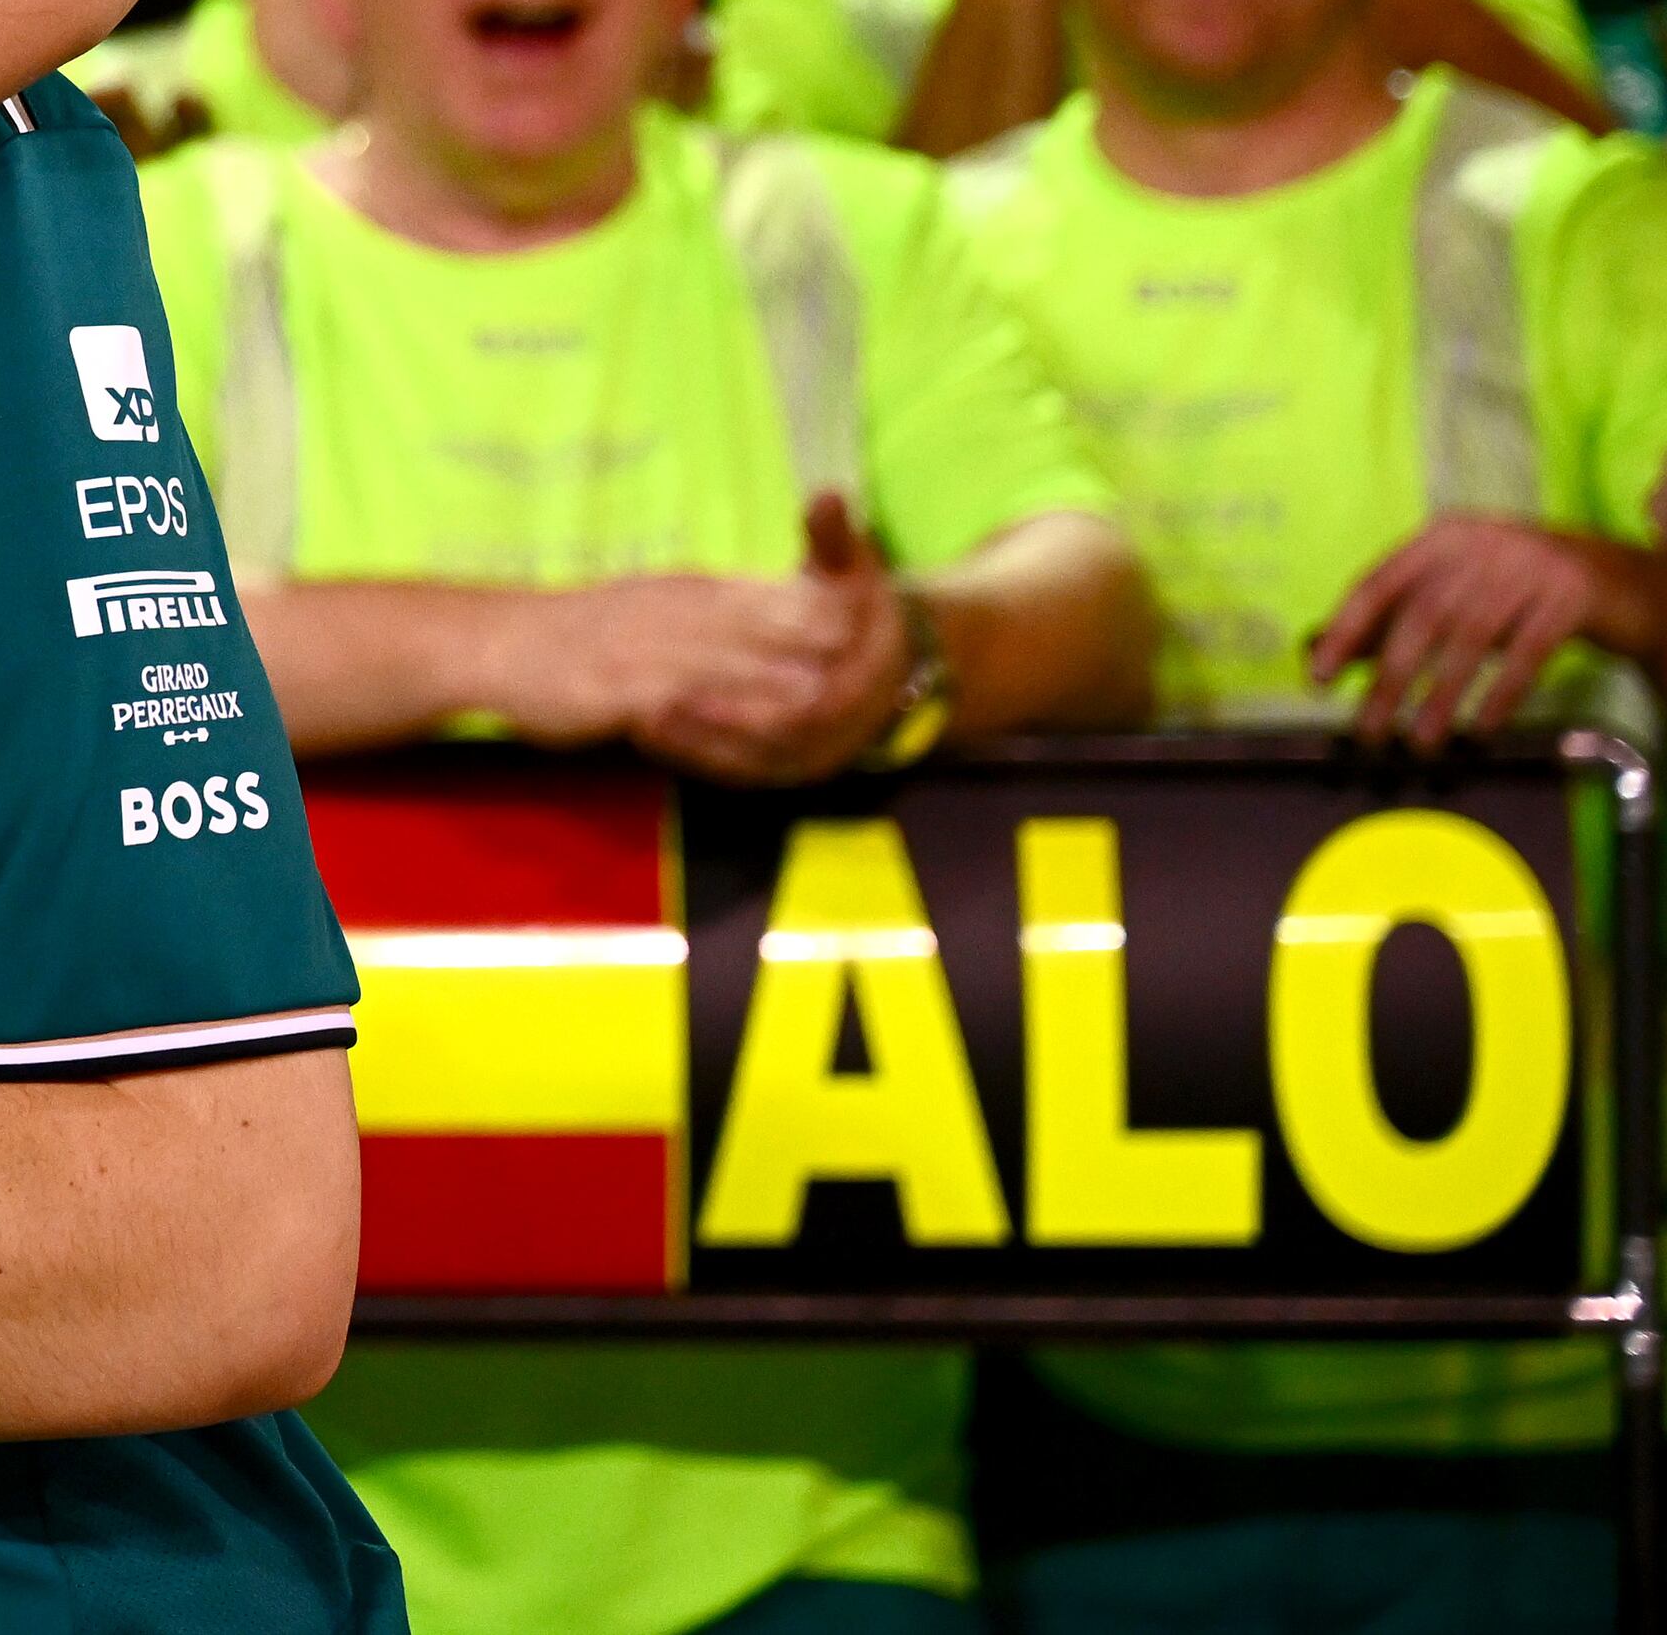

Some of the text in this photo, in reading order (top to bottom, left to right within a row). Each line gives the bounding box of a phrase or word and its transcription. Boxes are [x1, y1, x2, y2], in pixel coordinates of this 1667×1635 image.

[75, 475, 188, 539] EPOS
[66, 570, 228, 638] PIRELLI
[111, 691, 244, 731] PERREGAUX
[141, 663, 209, 693] GIRARD
[120, 771, 269, 847] BOSS
[693, 806, 1573, 1255] ALO
